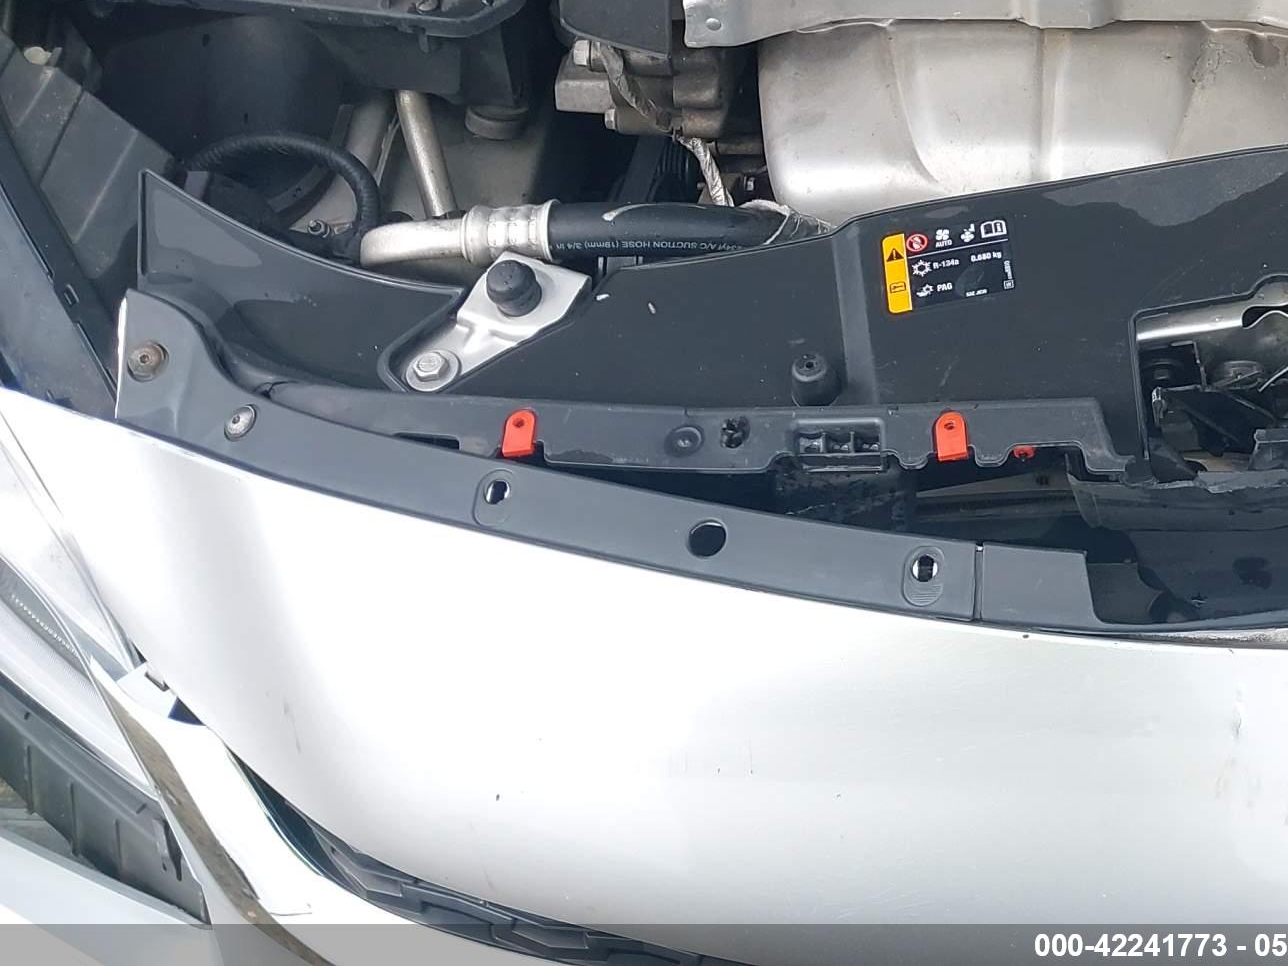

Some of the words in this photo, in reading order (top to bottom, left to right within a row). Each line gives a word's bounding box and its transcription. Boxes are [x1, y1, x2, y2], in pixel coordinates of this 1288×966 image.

[567, 242, 582, 250] 3/4
[622, 240, 650, 249] HOSE
[653, 241, 697, 250] SUCTION
[700, 242, 716, 251] A/C
[935, 239, 953, 248] AUTO
[932, 259, 960, 270] R-134a
[936, 282, 953, 292] PAG
